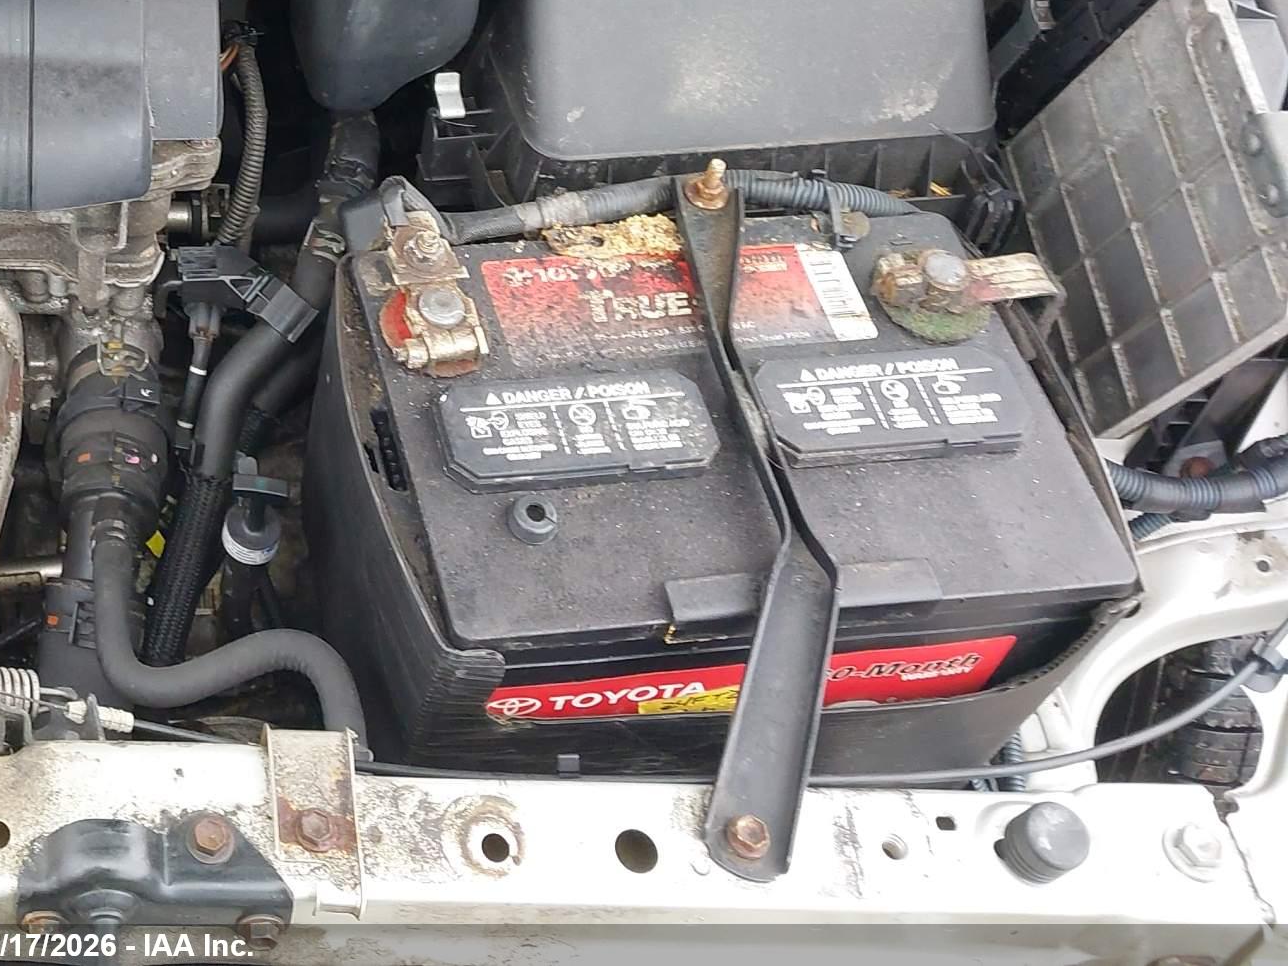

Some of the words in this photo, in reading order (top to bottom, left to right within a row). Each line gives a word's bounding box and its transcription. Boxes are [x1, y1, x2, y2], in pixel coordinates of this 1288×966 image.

[815, 364, 883, 381] DANGER
[897, 357, 960, 374] POISON
[502, 386, 572, 405] DANGER
[587, 381, 651, 398] POISON
[548, 681, 707, 710] TOYOTA
